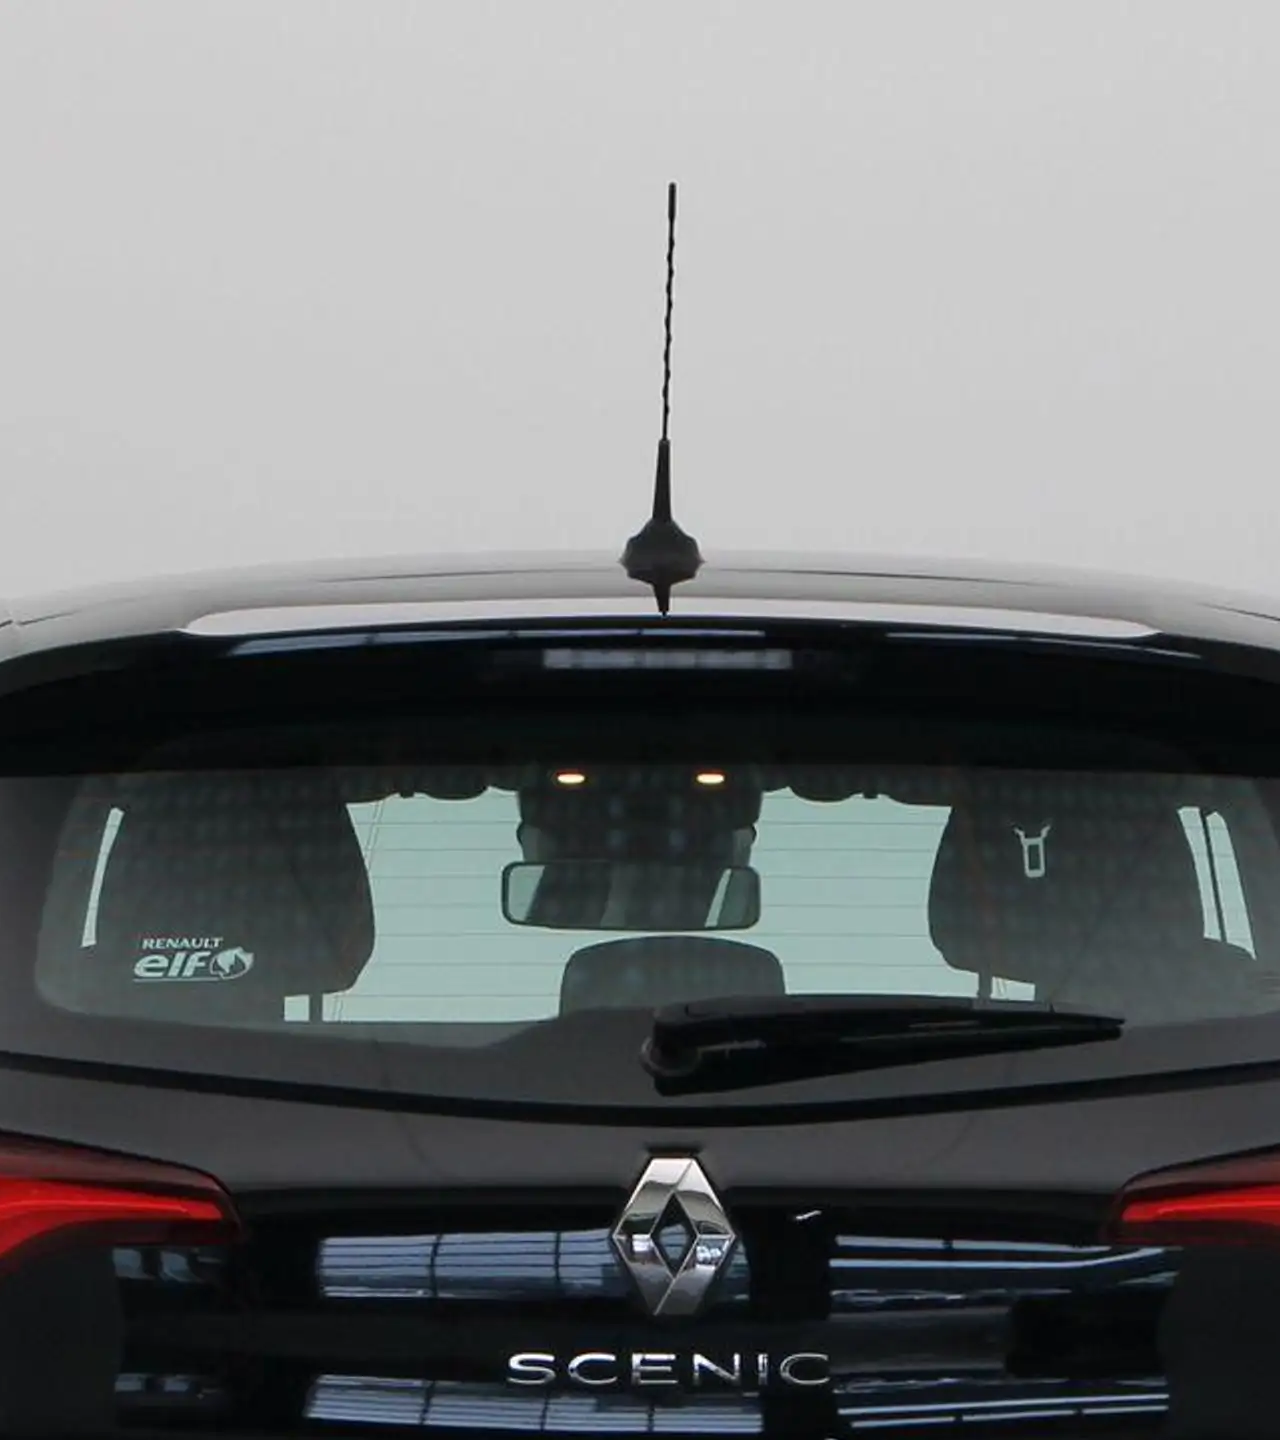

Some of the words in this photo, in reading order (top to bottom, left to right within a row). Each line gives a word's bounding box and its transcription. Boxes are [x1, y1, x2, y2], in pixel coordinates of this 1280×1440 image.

[141, 937, 224, 950] RENAULT
[133, 951, 211, 977] elf
[507, 1352, 830, 1386] SCENIC
